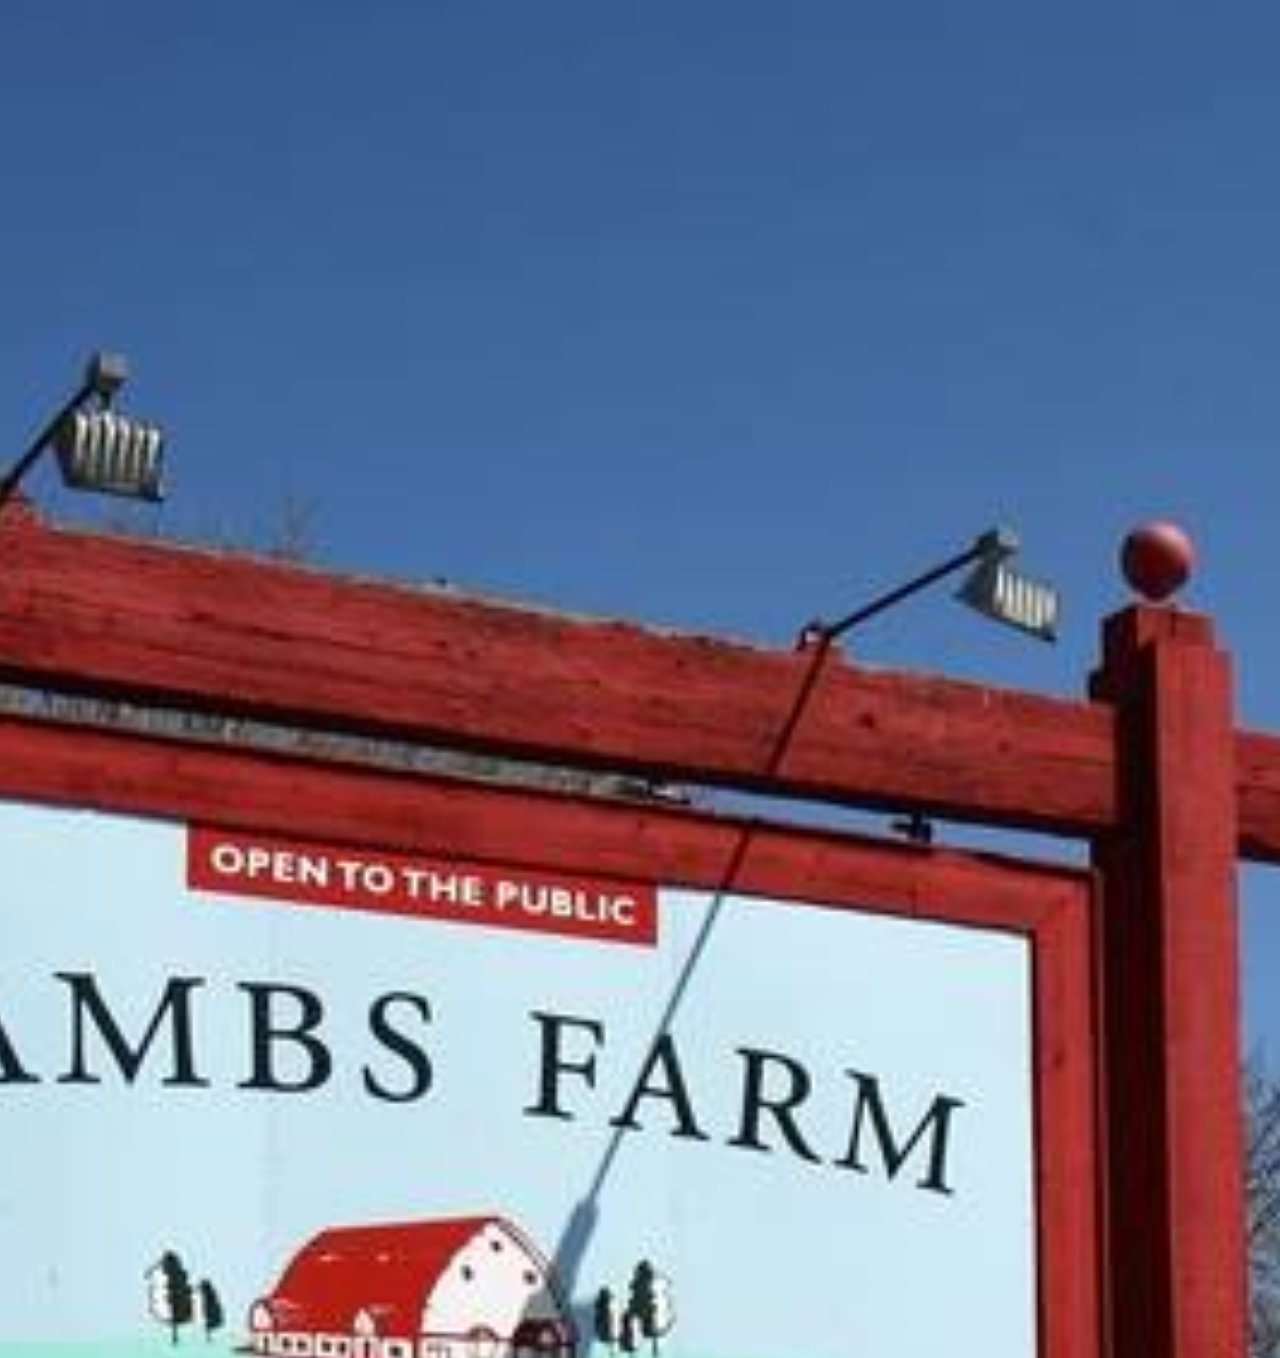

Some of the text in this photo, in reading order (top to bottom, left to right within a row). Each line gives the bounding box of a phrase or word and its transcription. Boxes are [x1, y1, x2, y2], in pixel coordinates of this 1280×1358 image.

[210, 845, 636, 926] OPEN TO THE PUBLIC
[522, 1010, 967, 1197] FARM
